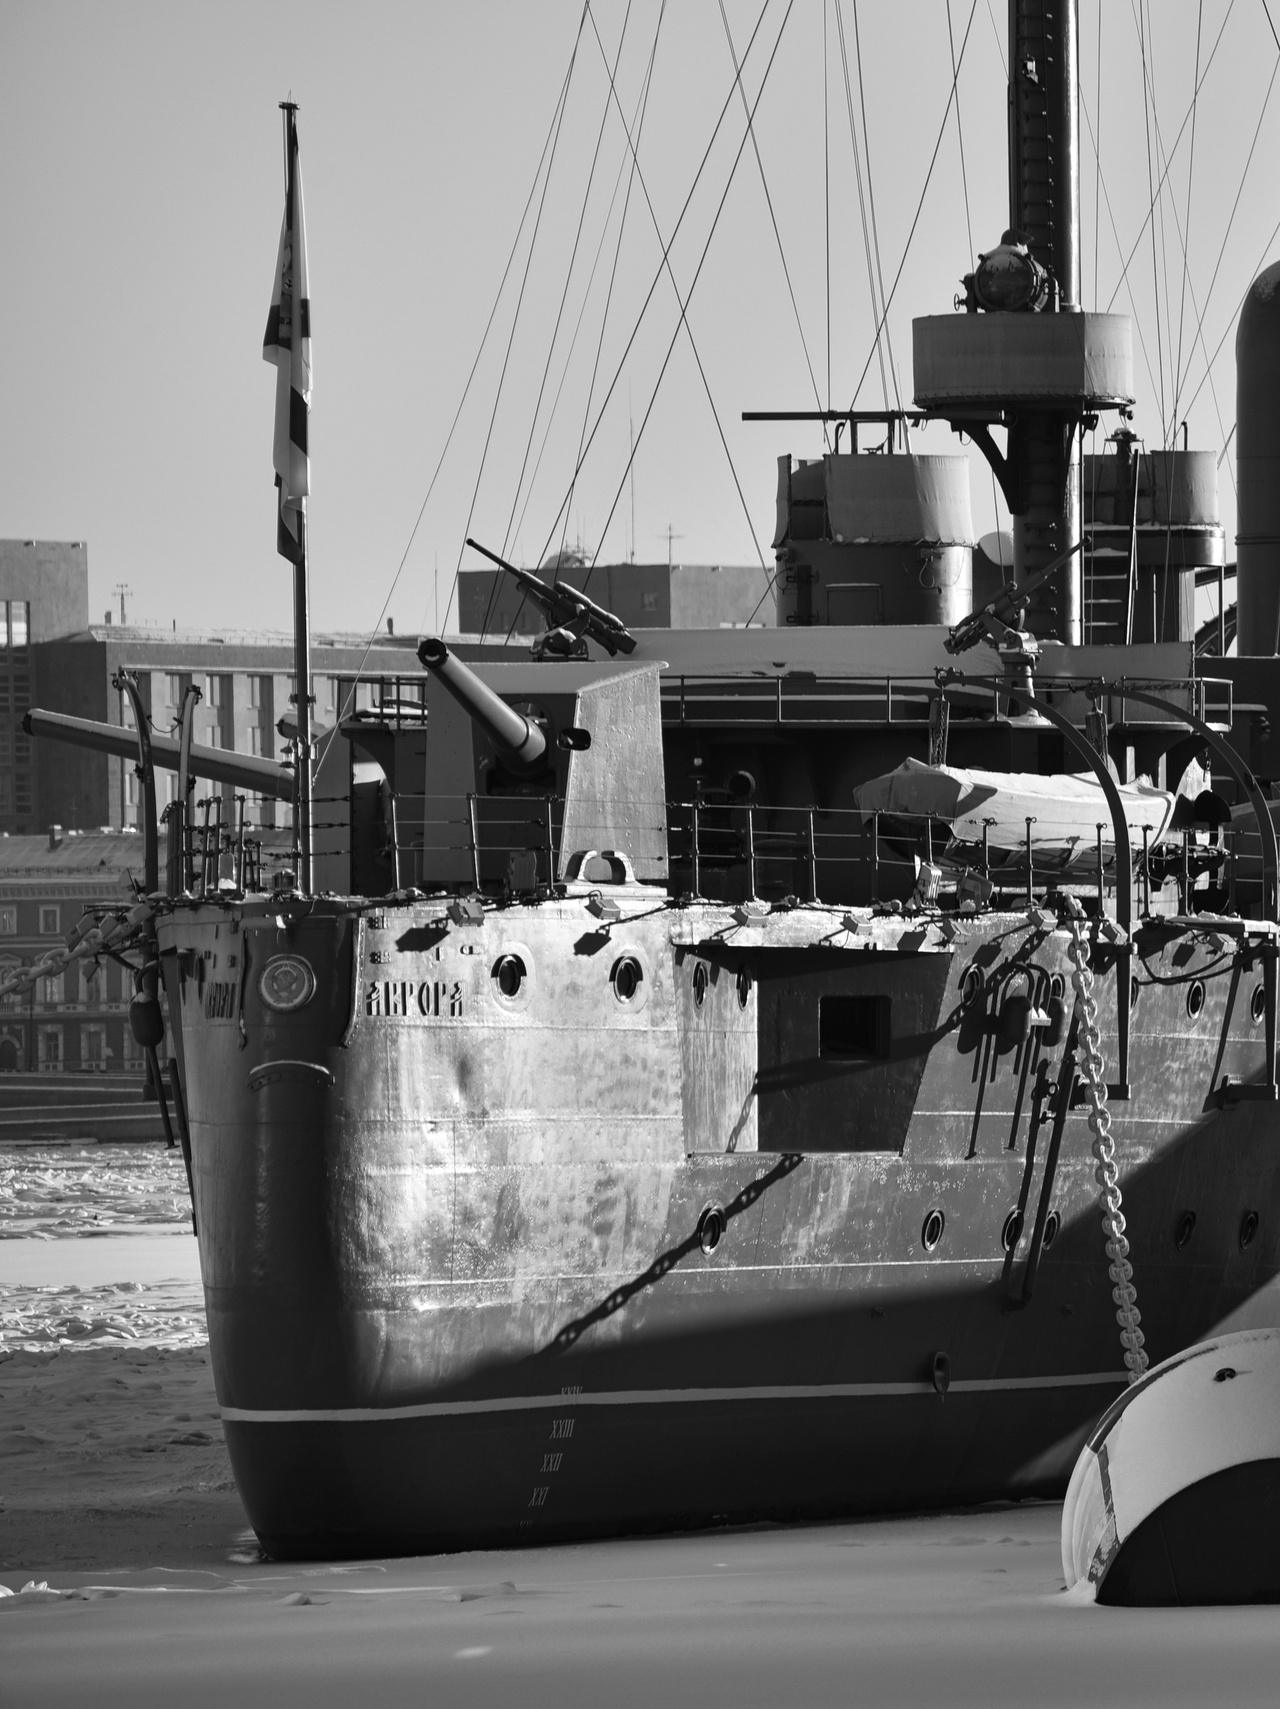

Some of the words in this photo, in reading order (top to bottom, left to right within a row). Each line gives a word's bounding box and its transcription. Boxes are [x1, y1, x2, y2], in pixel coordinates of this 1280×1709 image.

[365, 981, 464, 1017] АВРОРА
[549, 1418, 575, 1440] XXIII
[540, 1452, 563, 1473] XXII
[528, 1486, 549, 1507] XXI
